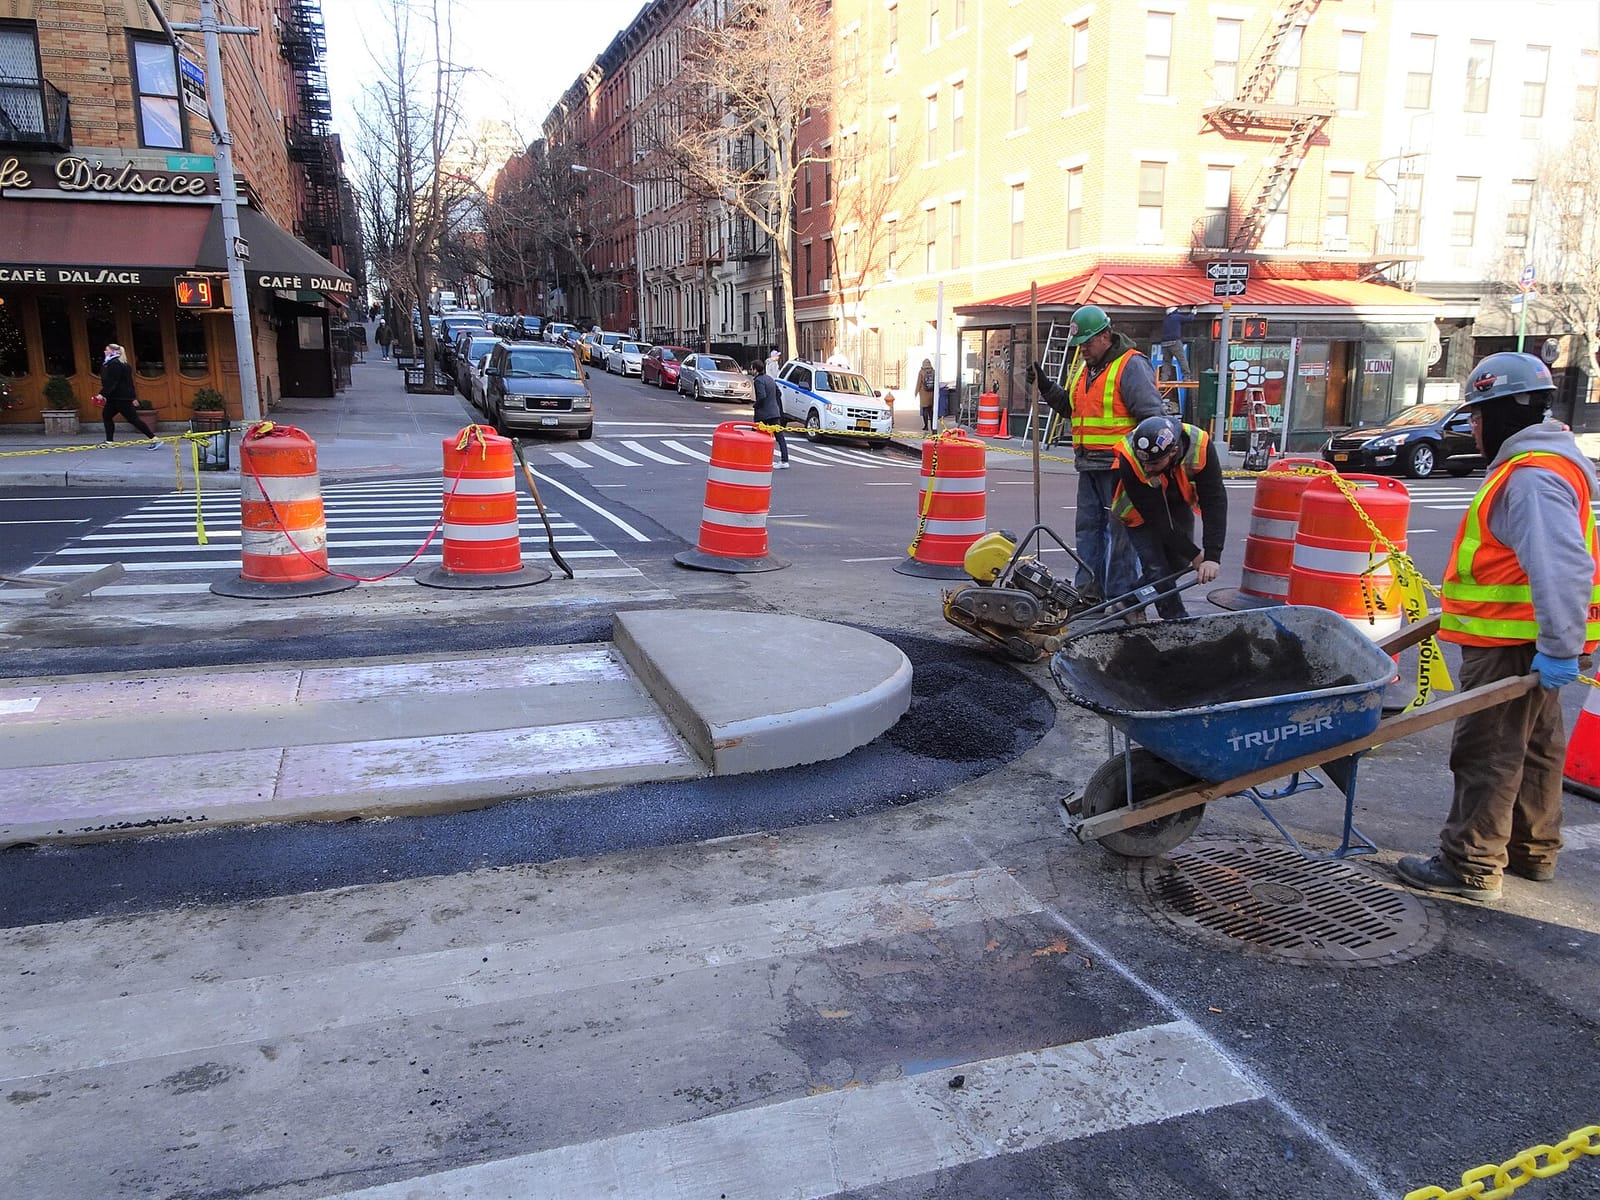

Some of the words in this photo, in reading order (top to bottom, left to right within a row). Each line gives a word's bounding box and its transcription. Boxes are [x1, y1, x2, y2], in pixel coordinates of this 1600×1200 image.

[180, 157, 189, 170] 2
[1211, 267, 1225, 276] ONE
[1232, 267, 1246, 275] WAY
[198, 283, 208, 302] 9
[1259, 321, 1266, 336] 9
[1413, 638, 1433, 708] CAUTION
[1227, 715, 1334, 752] TRUPER
